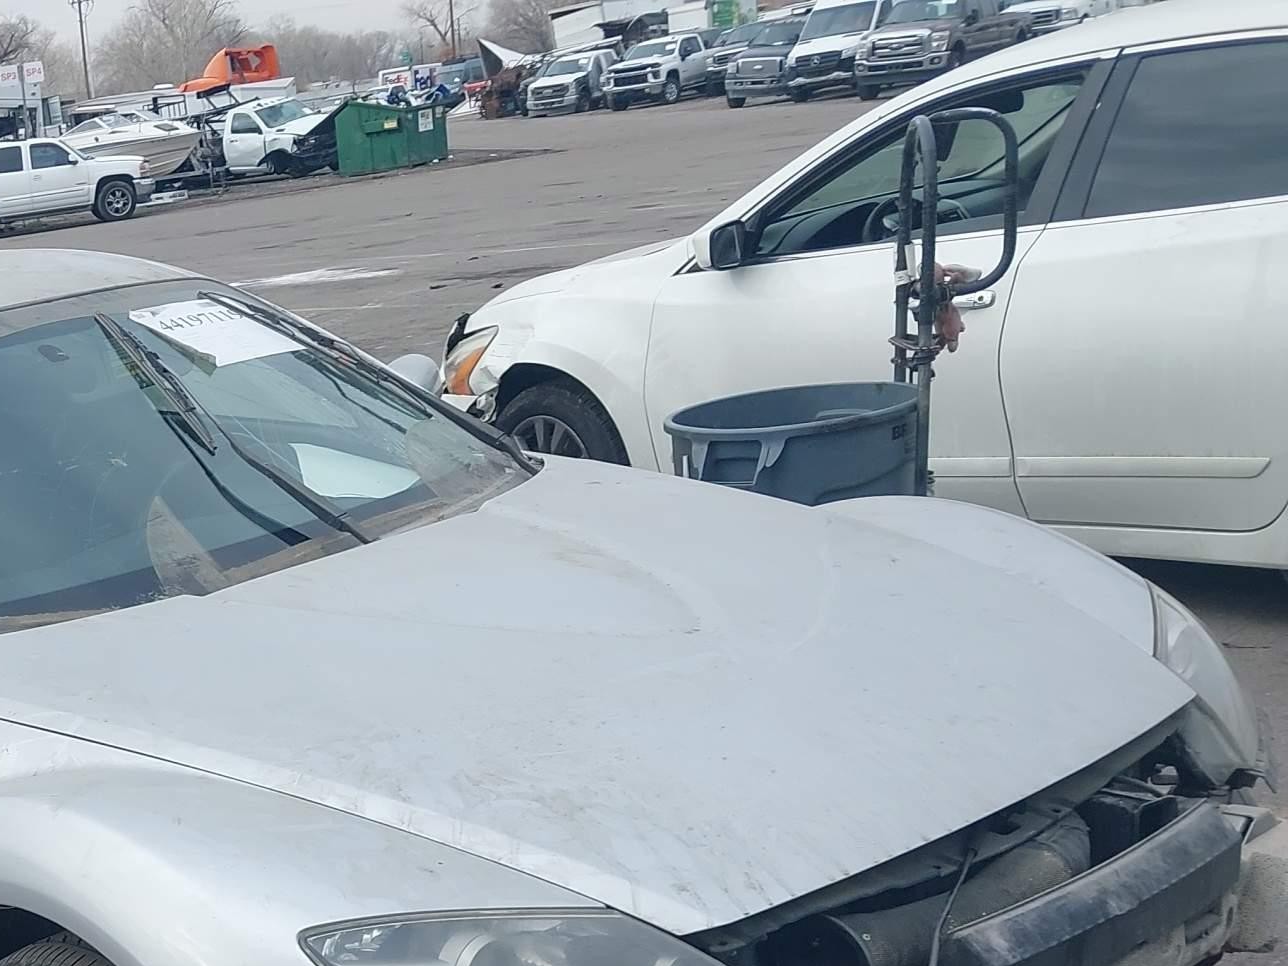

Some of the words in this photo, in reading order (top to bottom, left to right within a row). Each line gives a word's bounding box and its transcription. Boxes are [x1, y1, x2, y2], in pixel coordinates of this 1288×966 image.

[0, 72, 17, 81] SP3
[25, 67, 42, 77] SP4
[385, 74, 409, 85] FedEx
